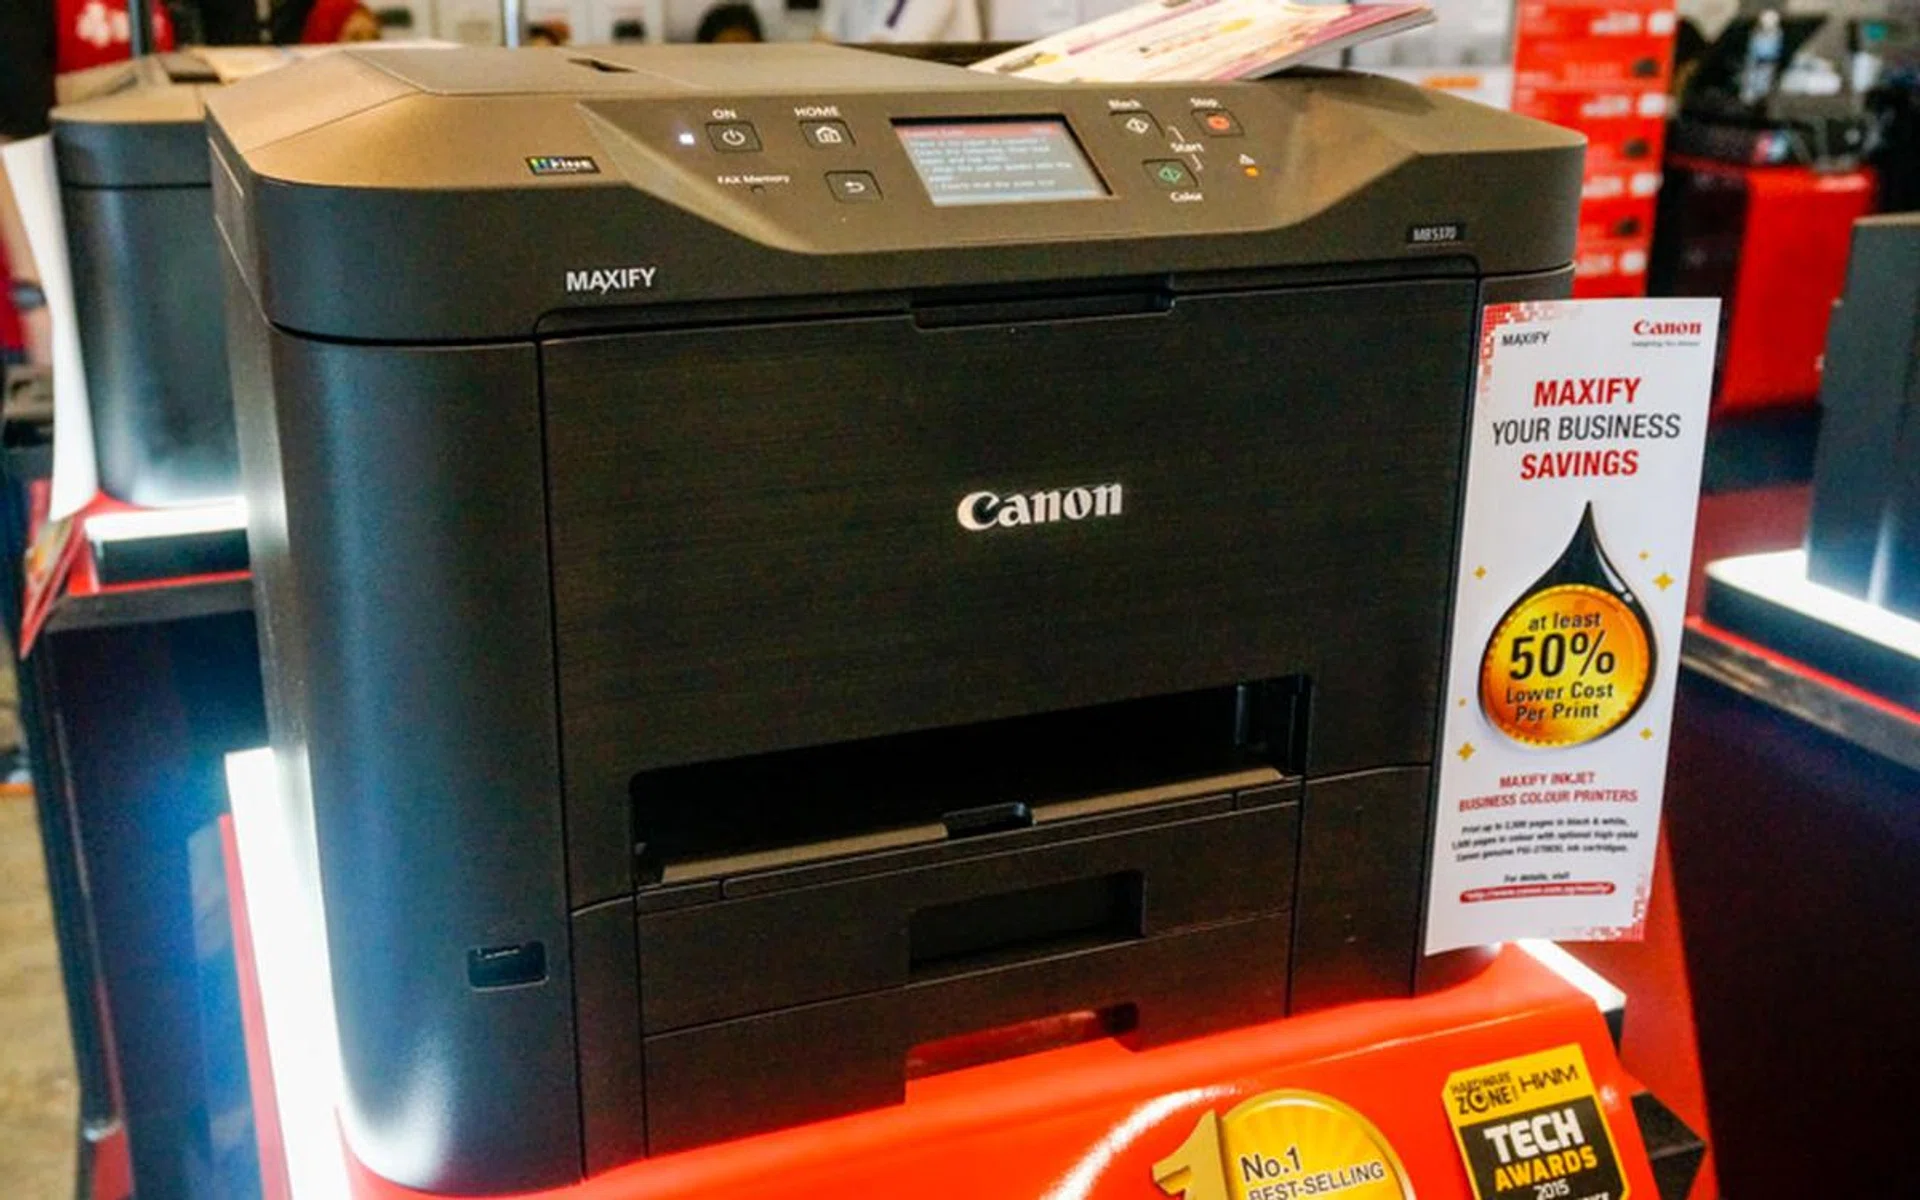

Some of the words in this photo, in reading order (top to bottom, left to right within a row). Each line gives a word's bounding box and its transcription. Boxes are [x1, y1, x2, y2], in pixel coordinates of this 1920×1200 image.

[712, 108, 738, 119] ON
[794, 105, 841, 117] HOME
[1170, 142, 1204, 152] Start
[566, 267, 656, 294] MAXIFY
[1501, 331, 1549, 347] MAXIFY
[1633, 319, 1702, 335] Canon
[1533, 377, 1641, 408] MAXIFY
[1492, 418, 1549, 445] YOUR
[1557, 413, 1681, 441] BUSINESS
[1520, 449, 1639, 481] SAVINGS
[957, 482, 1122, 531] Canon
[1528, 616, 1547, 631] at
[1553, 611, 1601, 630] least
[1509, 630, 1615, 681] 50%
[1506, 686, 1564, 704] Lower
[1570, 681, 1614, 699] Cost
[1515, 705, 1546, 722] Per
[1552, 702, 1599, 719] Print
[1500, 774, 1547, 788] MAXIFY
[1550, 771, 1595, 785] INKJET
[1459, 793, 1517, 812] BUSINESS
[1519, 790, 1570, 805] COLOUR
[1573, 788, 1638, 803] PRINTERS
[1519, 1063, 1580, 1094] HWM
[1484, 1107, 1585, 1164] TECH
[1240, 1146, 1302, 1182] No.1
[1494, 1145, 1598, 1192] AWARDS
[1249, 1161, 1385, 1200] BEST-SELLING
[1533, 1177, 1571, 1200] 2015
